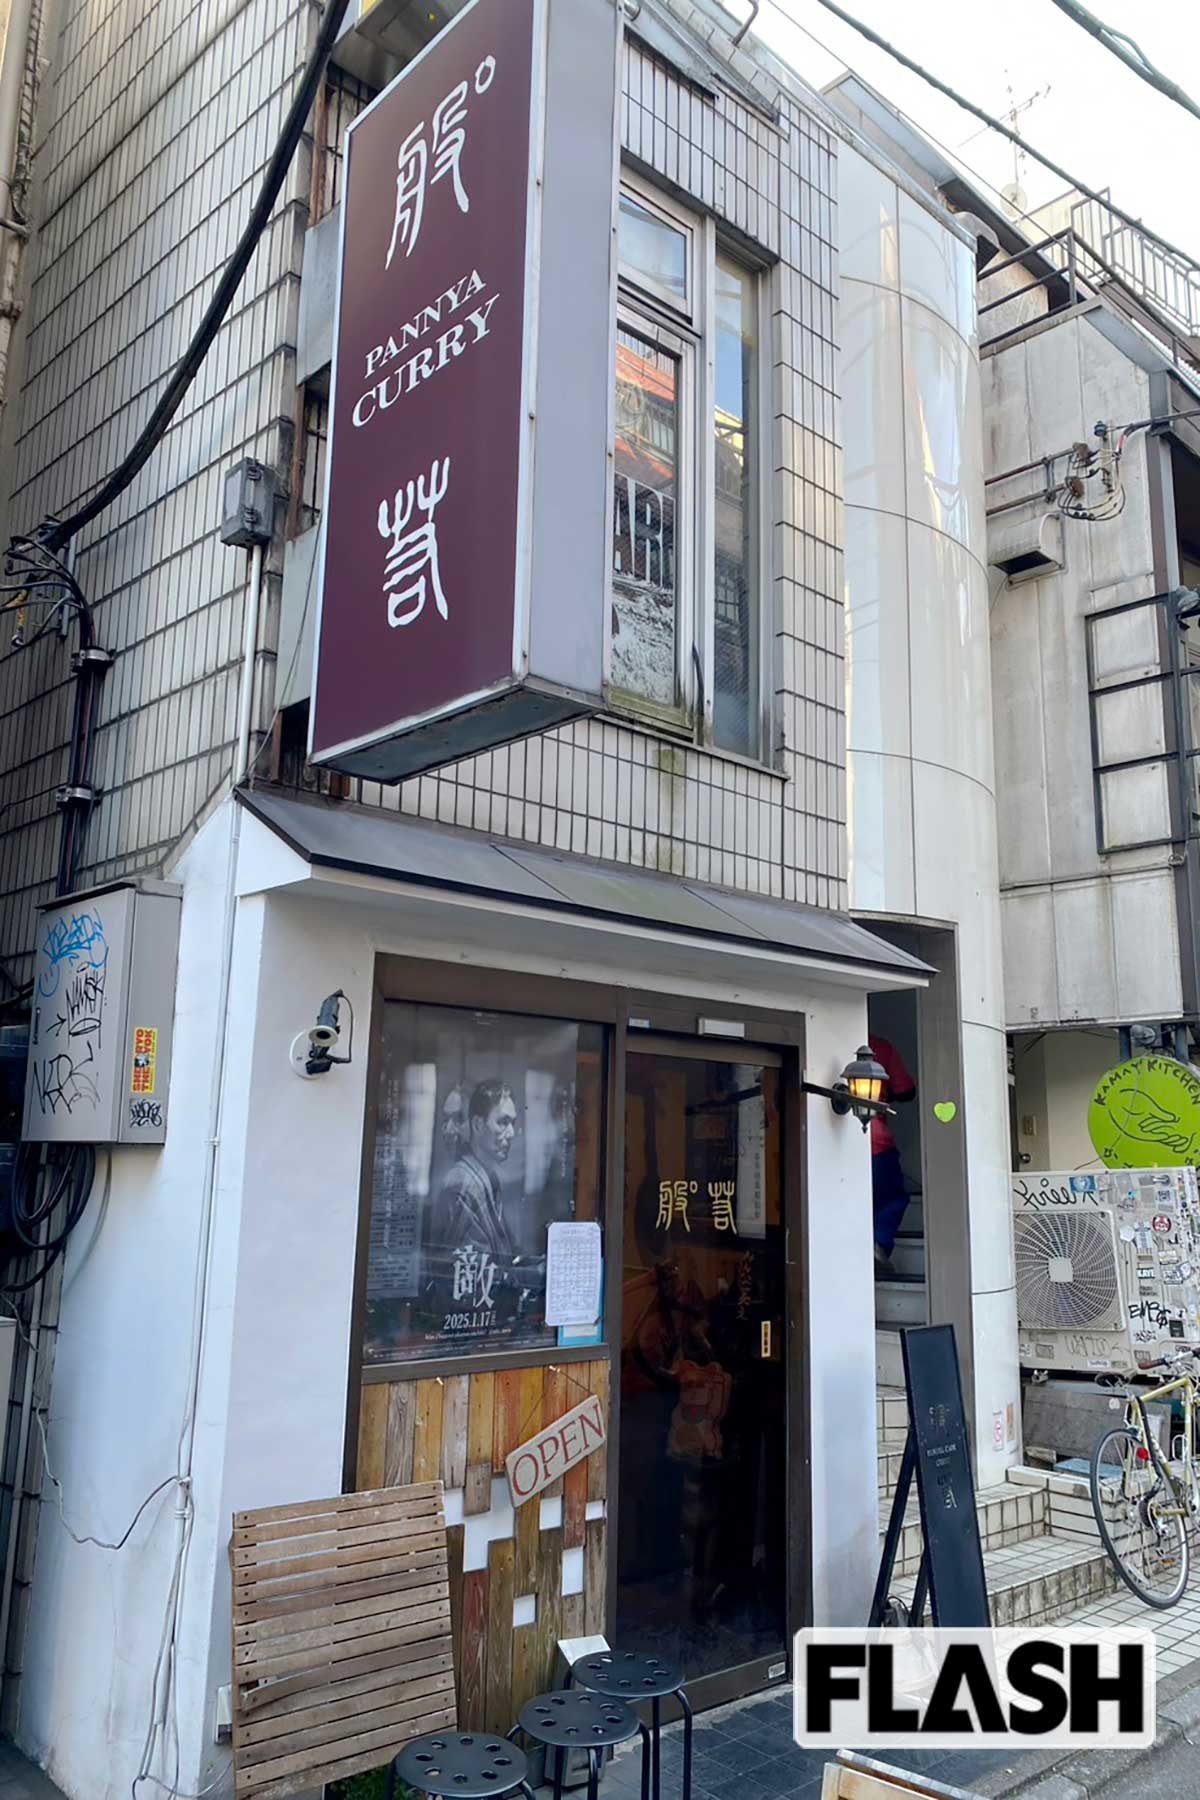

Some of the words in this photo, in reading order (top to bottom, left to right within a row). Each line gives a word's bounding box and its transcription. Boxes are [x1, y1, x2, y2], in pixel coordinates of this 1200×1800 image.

[351, 293, 500, 427] CURRY
[364, 269, 486, 379] PANNYA
[1094, 1060, 1143, 1106] KAMAY
[1147, 1059, 1200, 1105] KITCHEN
[452, 1245, 498, 1309] 敵
[443, 1311, 491, 1330] 2025.1.17
[512, 1403, 603, 1496] OPEN
